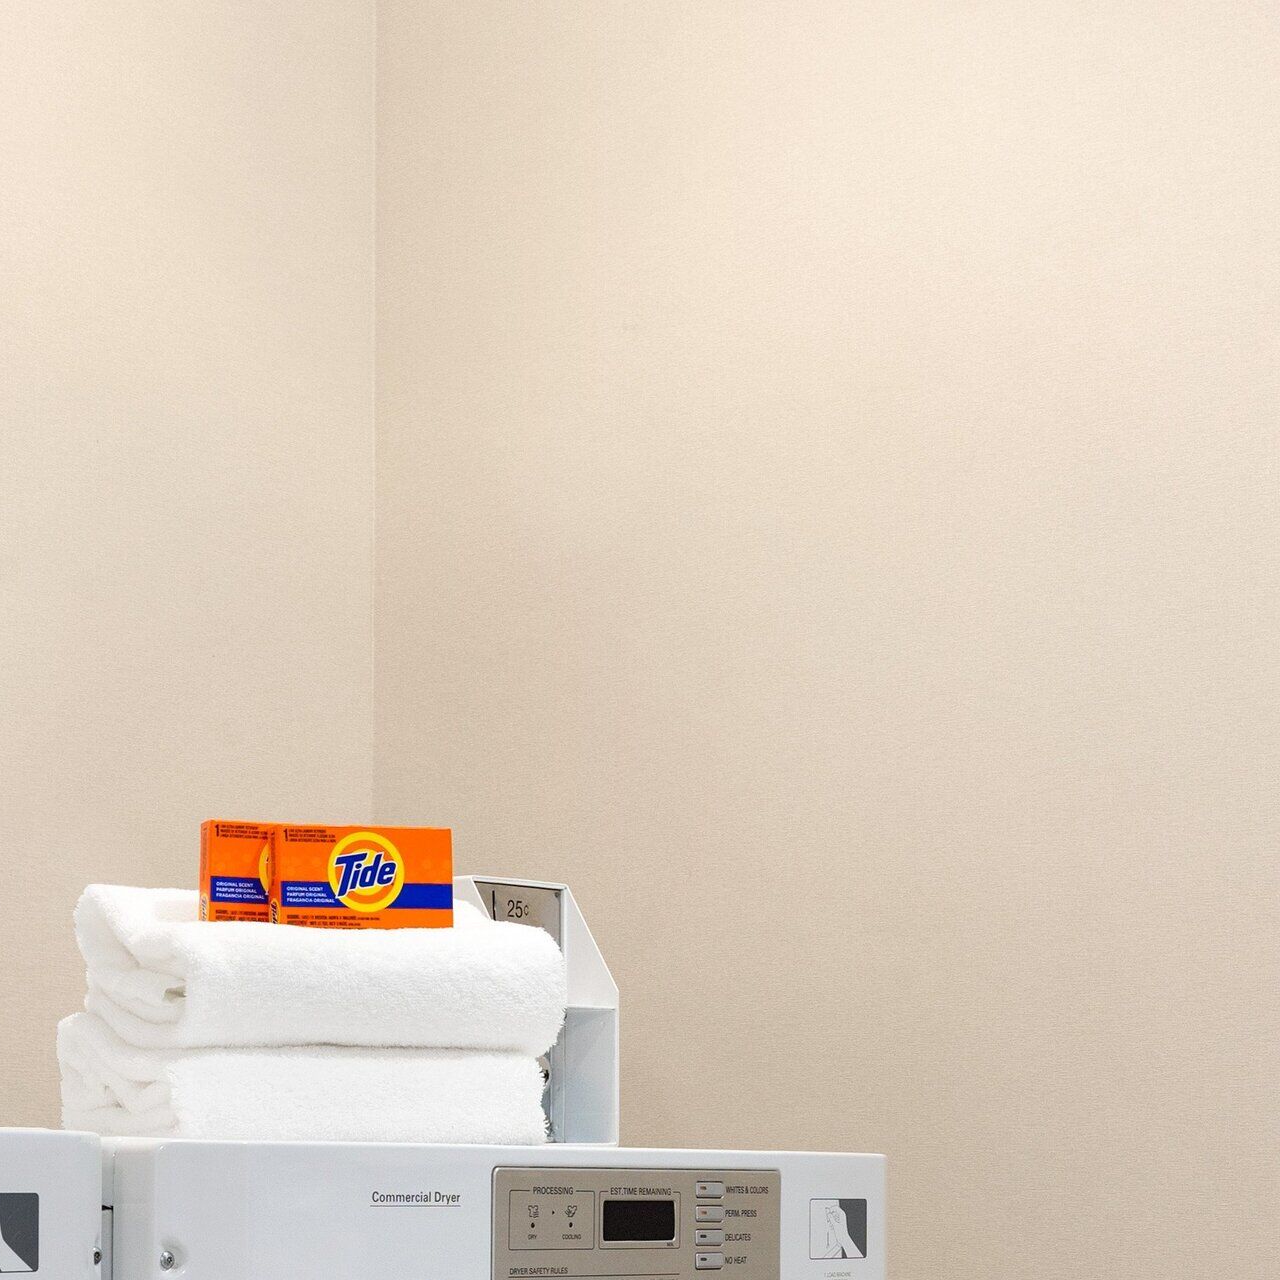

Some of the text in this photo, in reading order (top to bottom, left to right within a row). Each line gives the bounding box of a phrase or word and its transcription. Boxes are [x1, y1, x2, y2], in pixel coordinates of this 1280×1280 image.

[334, 852, 397, 899] Tide
[507, 900, 530, 918] 25¢
[372, 1190, 461, 1205] Commercial Dryer
[532, 1186, 574, 1195] PROCESSING
[638, 1187, 672, 1195] REMAINING
